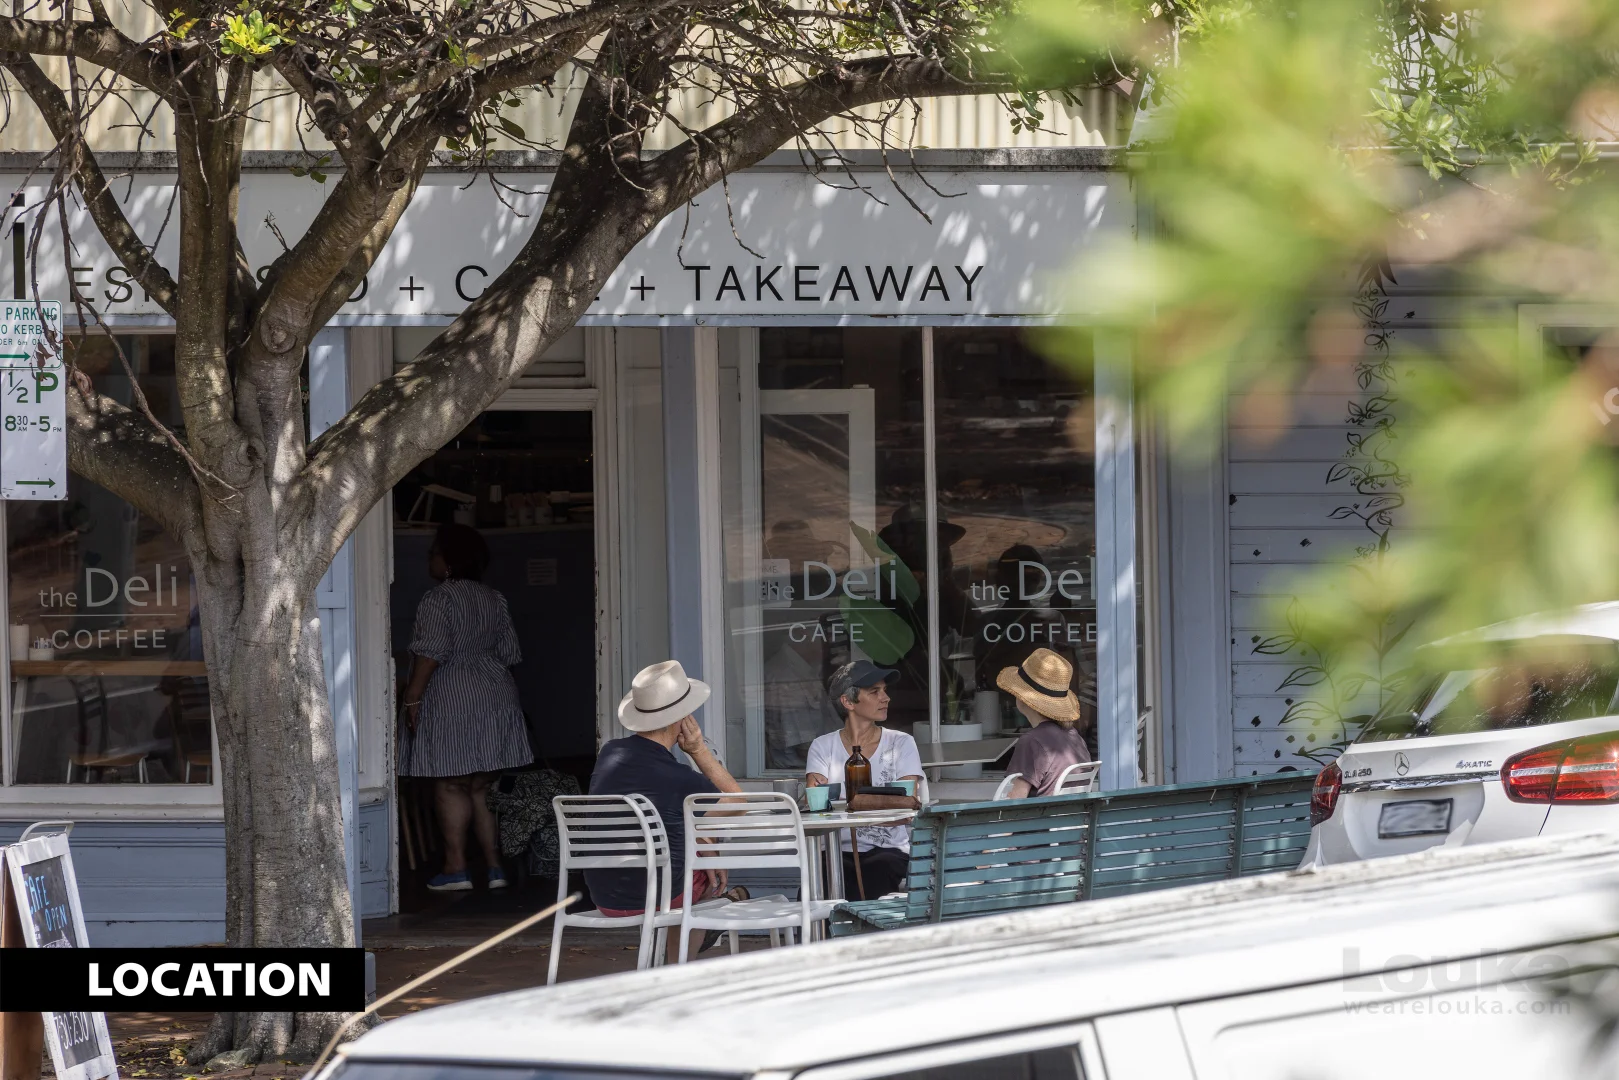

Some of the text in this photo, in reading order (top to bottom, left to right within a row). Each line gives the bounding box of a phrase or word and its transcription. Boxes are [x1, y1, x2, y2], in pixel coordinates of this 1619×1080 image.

[683, 265, 984, 302] TAKEAWAY
[6, 307, 58, 321] PARKNG
[14, 324, 43, 335] KERB
[35, 371, 59, 404] P
[38, 563, 178, 608] the Deli
[803, 557, 897, 601] Deli
[970, 557, 1097, 601] the Del
[51, 629, 167, 650] COFFEE
[788, 623, 865, 643] CAFE
[983, 623, 1097, 643] COFFEE
[45, 904, 68, 932] OPEN
